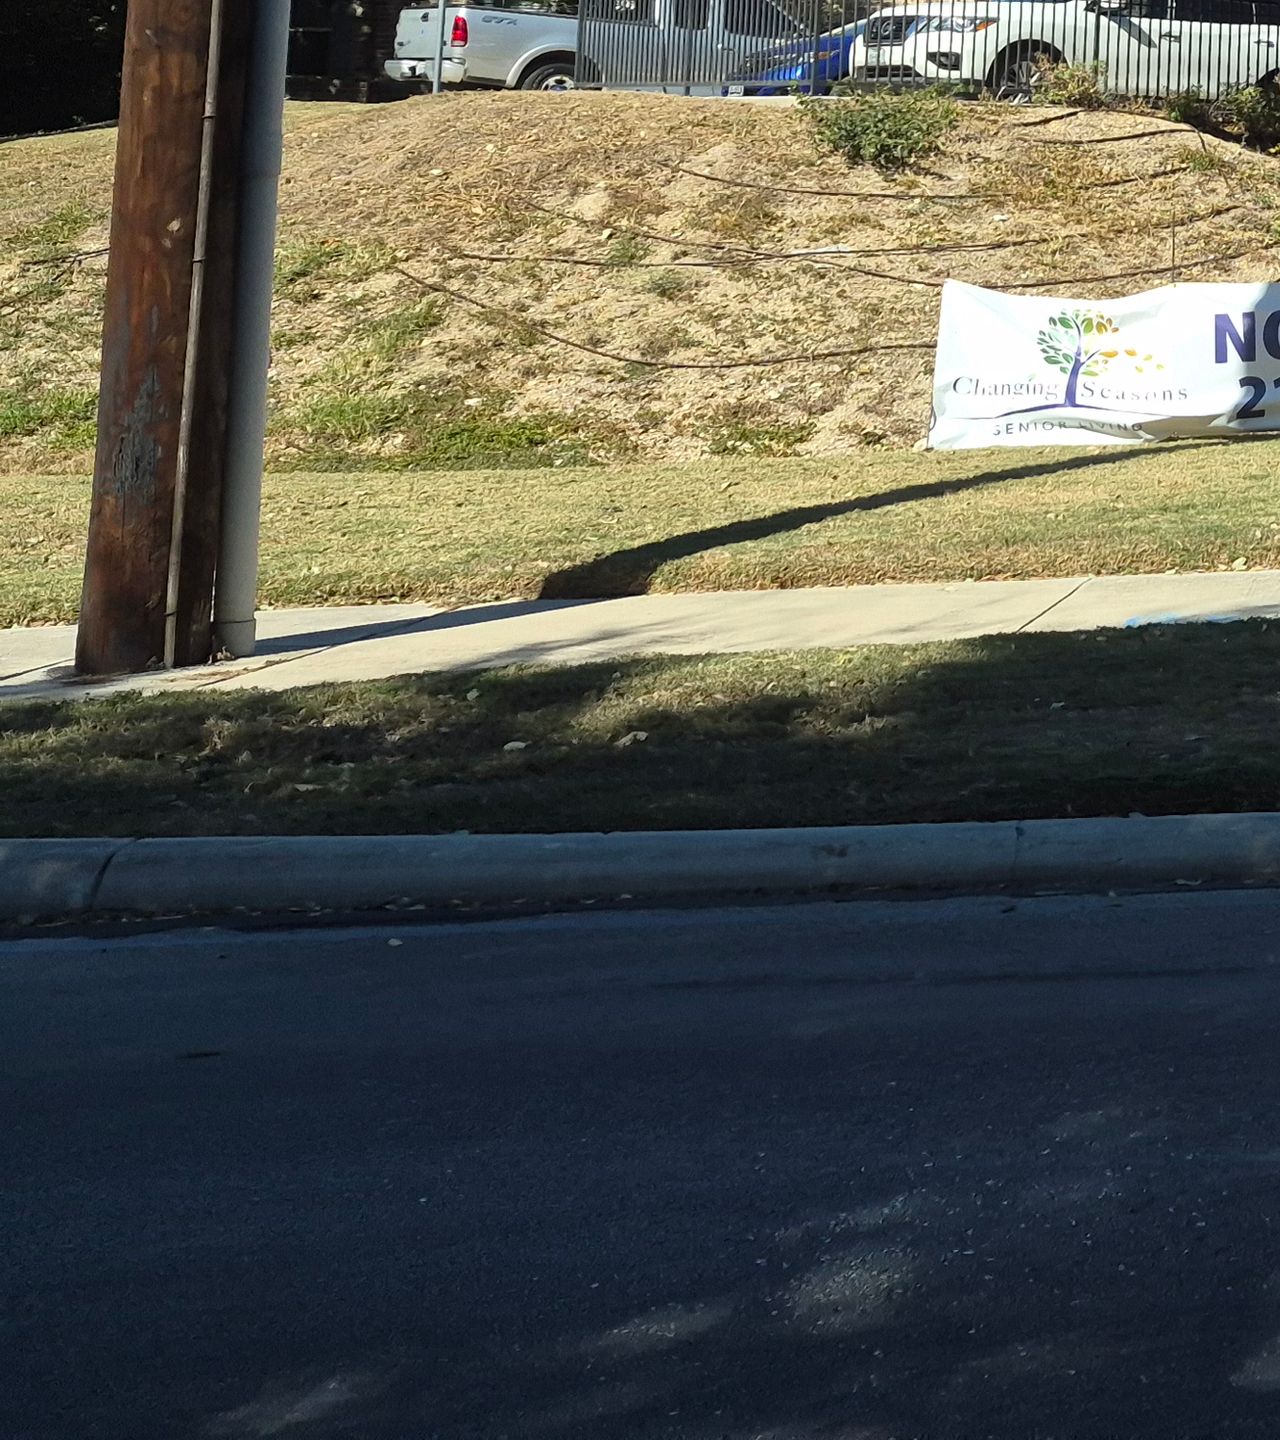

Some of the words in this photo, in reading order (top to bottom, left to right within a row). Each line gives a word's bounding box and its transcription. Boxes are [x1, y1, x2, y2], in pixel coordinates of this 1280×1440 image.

[952, 375, 1058, 401] Changing
[1081, 380, 1188, 401] Seasons
[993, 420, 1068, 436] SENIOR
